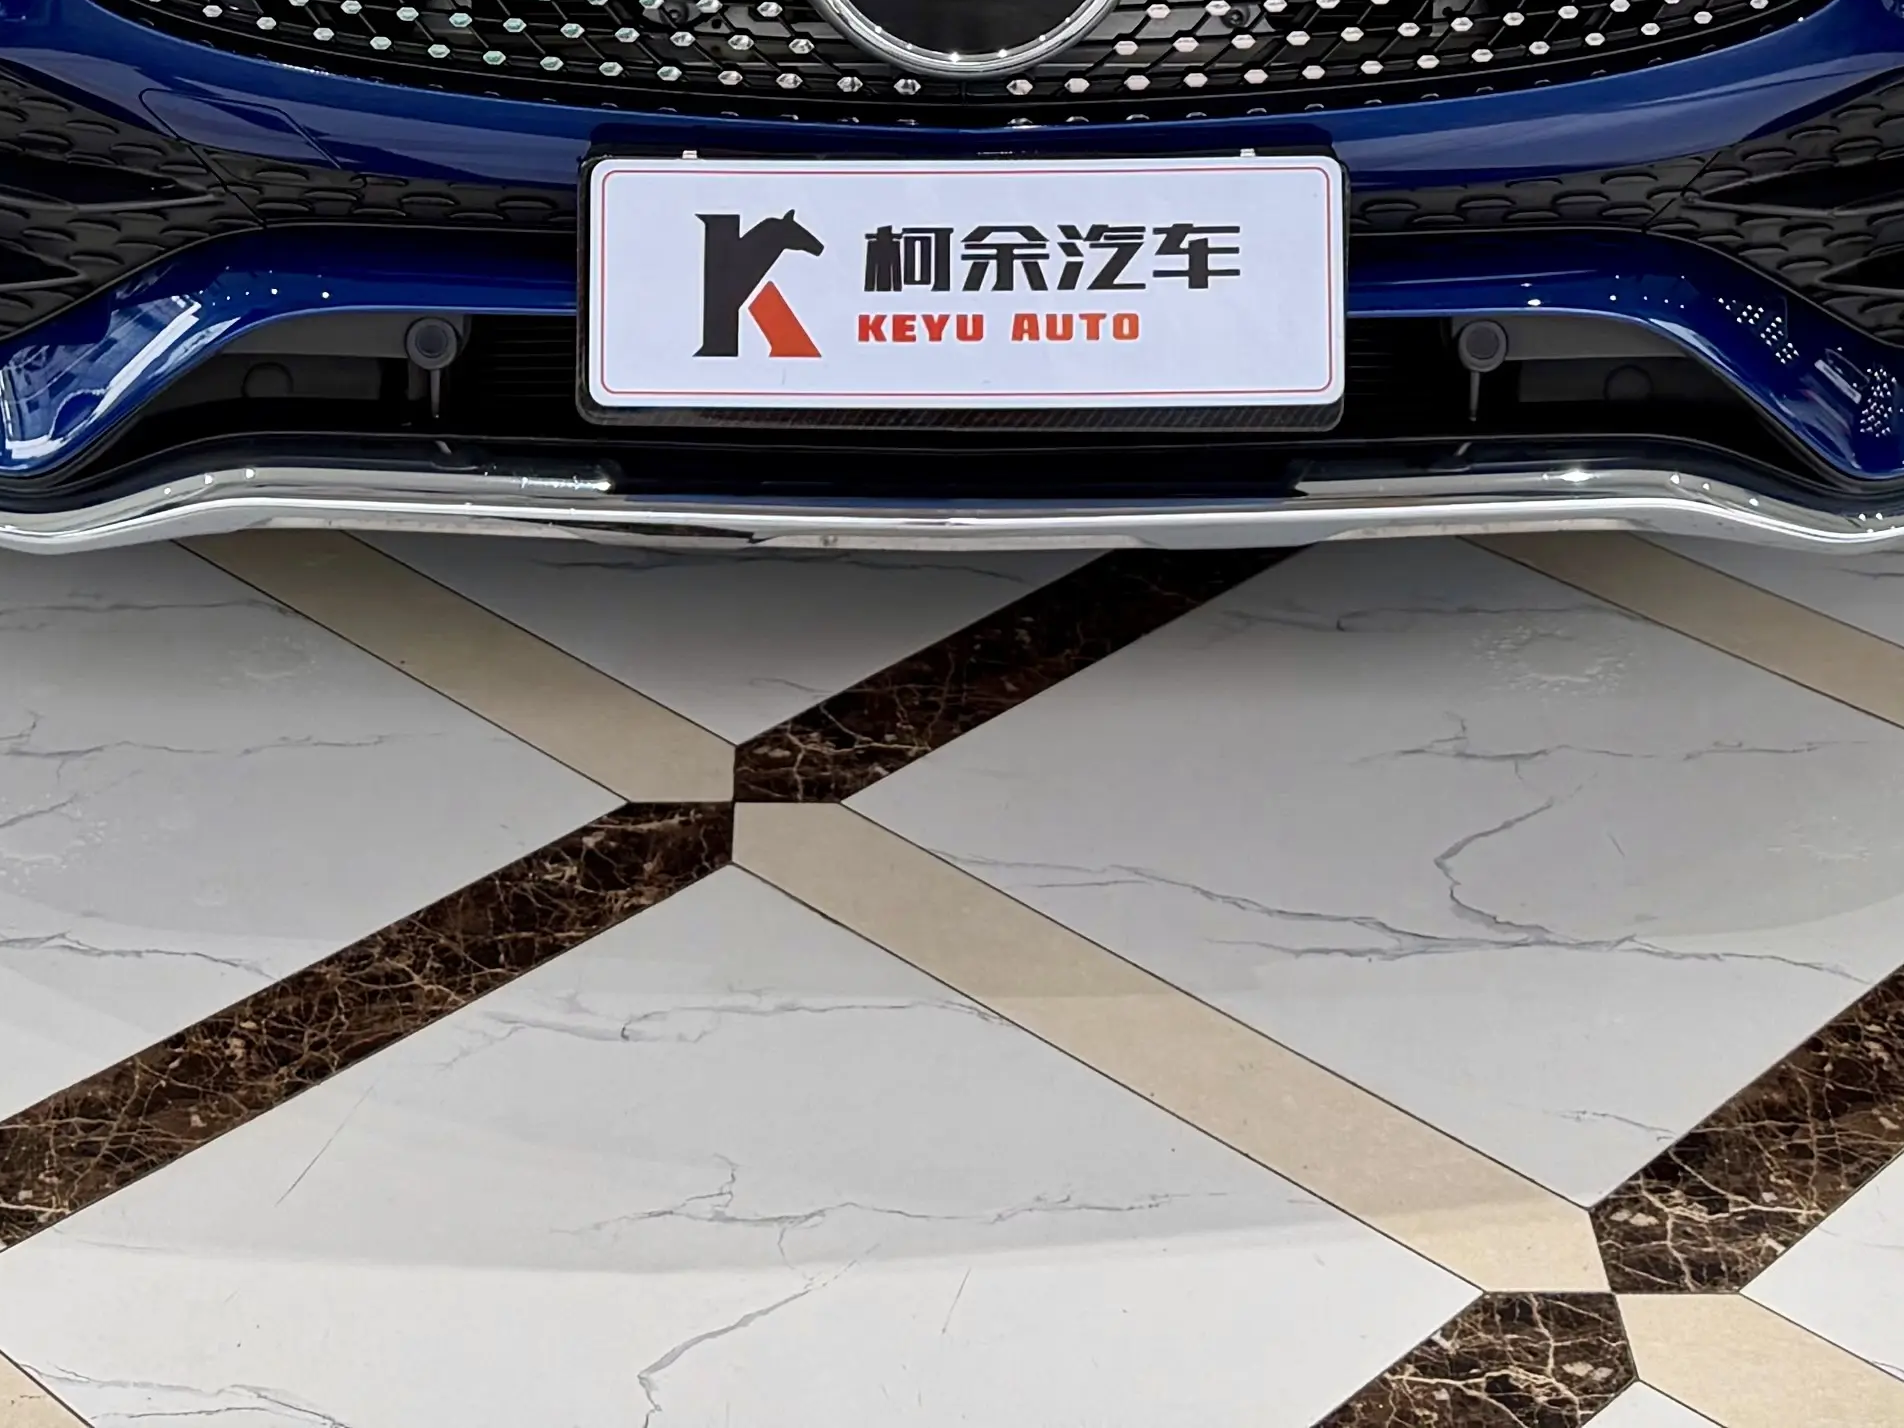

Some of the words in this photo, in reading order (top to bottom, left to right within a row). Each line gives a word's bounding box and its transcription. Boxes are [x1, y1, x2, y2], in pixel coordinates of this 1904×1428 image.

[864, 222, 1242, 293] 柯余汽车
[858, 313, 984, 343] KEYU
[1011, 312, 1141, 342] AUTO
